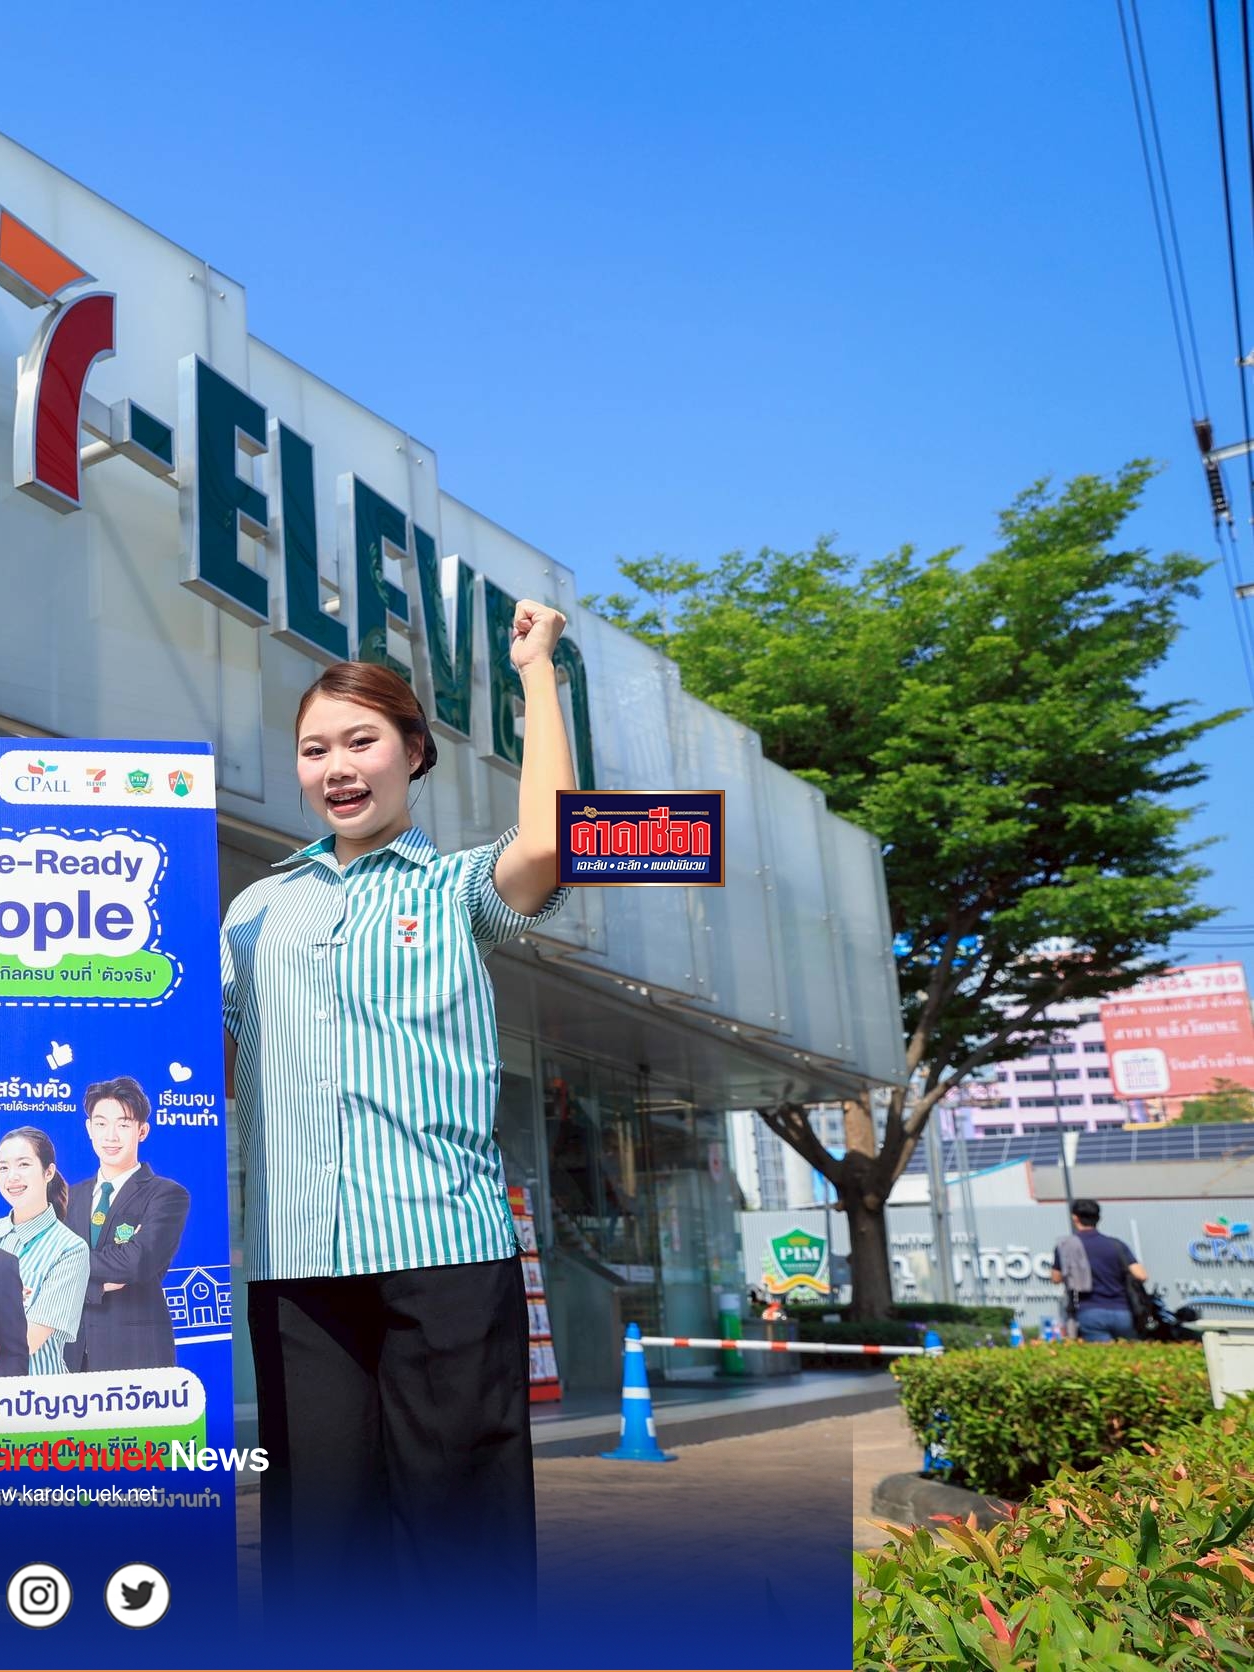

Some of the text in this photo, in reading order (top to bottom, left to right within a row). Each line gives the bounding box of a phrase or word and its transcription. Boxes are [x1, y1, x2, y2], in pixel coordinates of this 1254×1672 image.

[60, 961, 92, 981] จบที่
[159, 1089, 215, 1107] เรียนจบ
[156, 1108, 219, 1127] มีงานทำ
[779, 1246, 820, 1261] PIM
